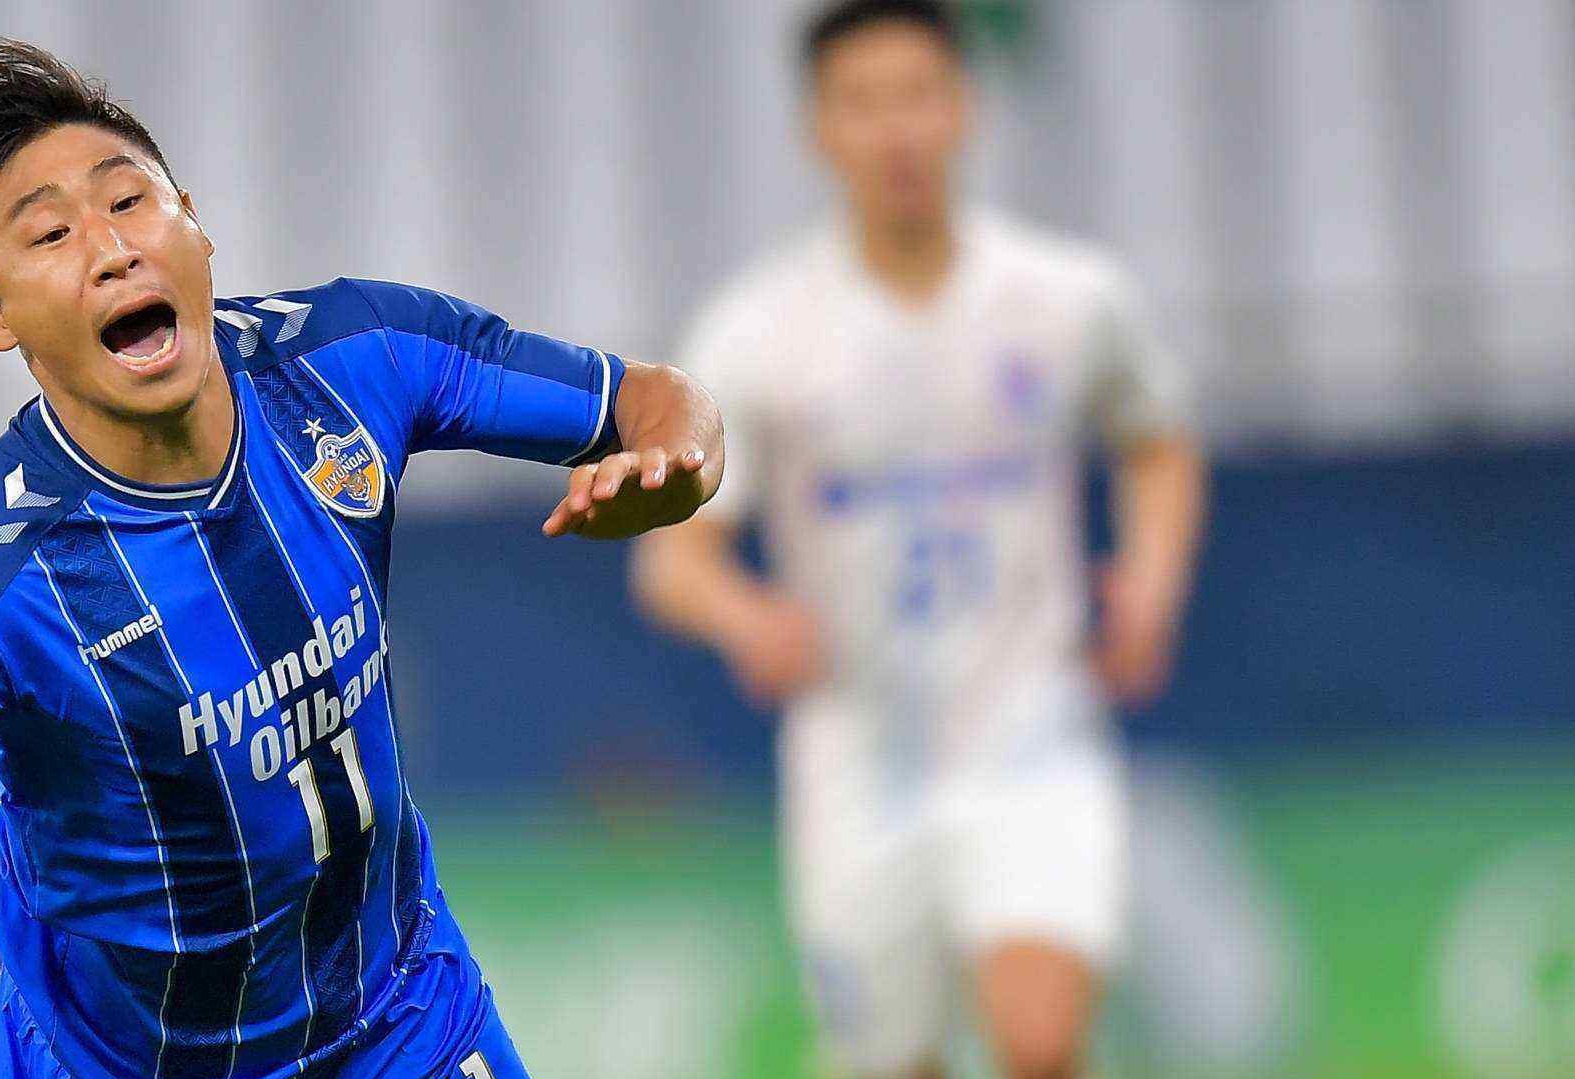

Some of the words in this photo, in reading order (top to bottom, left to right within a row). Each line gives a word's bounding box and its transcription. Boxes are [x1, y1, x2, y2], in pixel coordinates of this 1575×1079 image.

[322, 448, 371, 494] HYUNDAI
[77, 604, 163, 666] hummel
[178, 584, 366, 757] Hyundai
[249, 620, 388, 783] Oilban
[287, 726, 375, 864] 11
